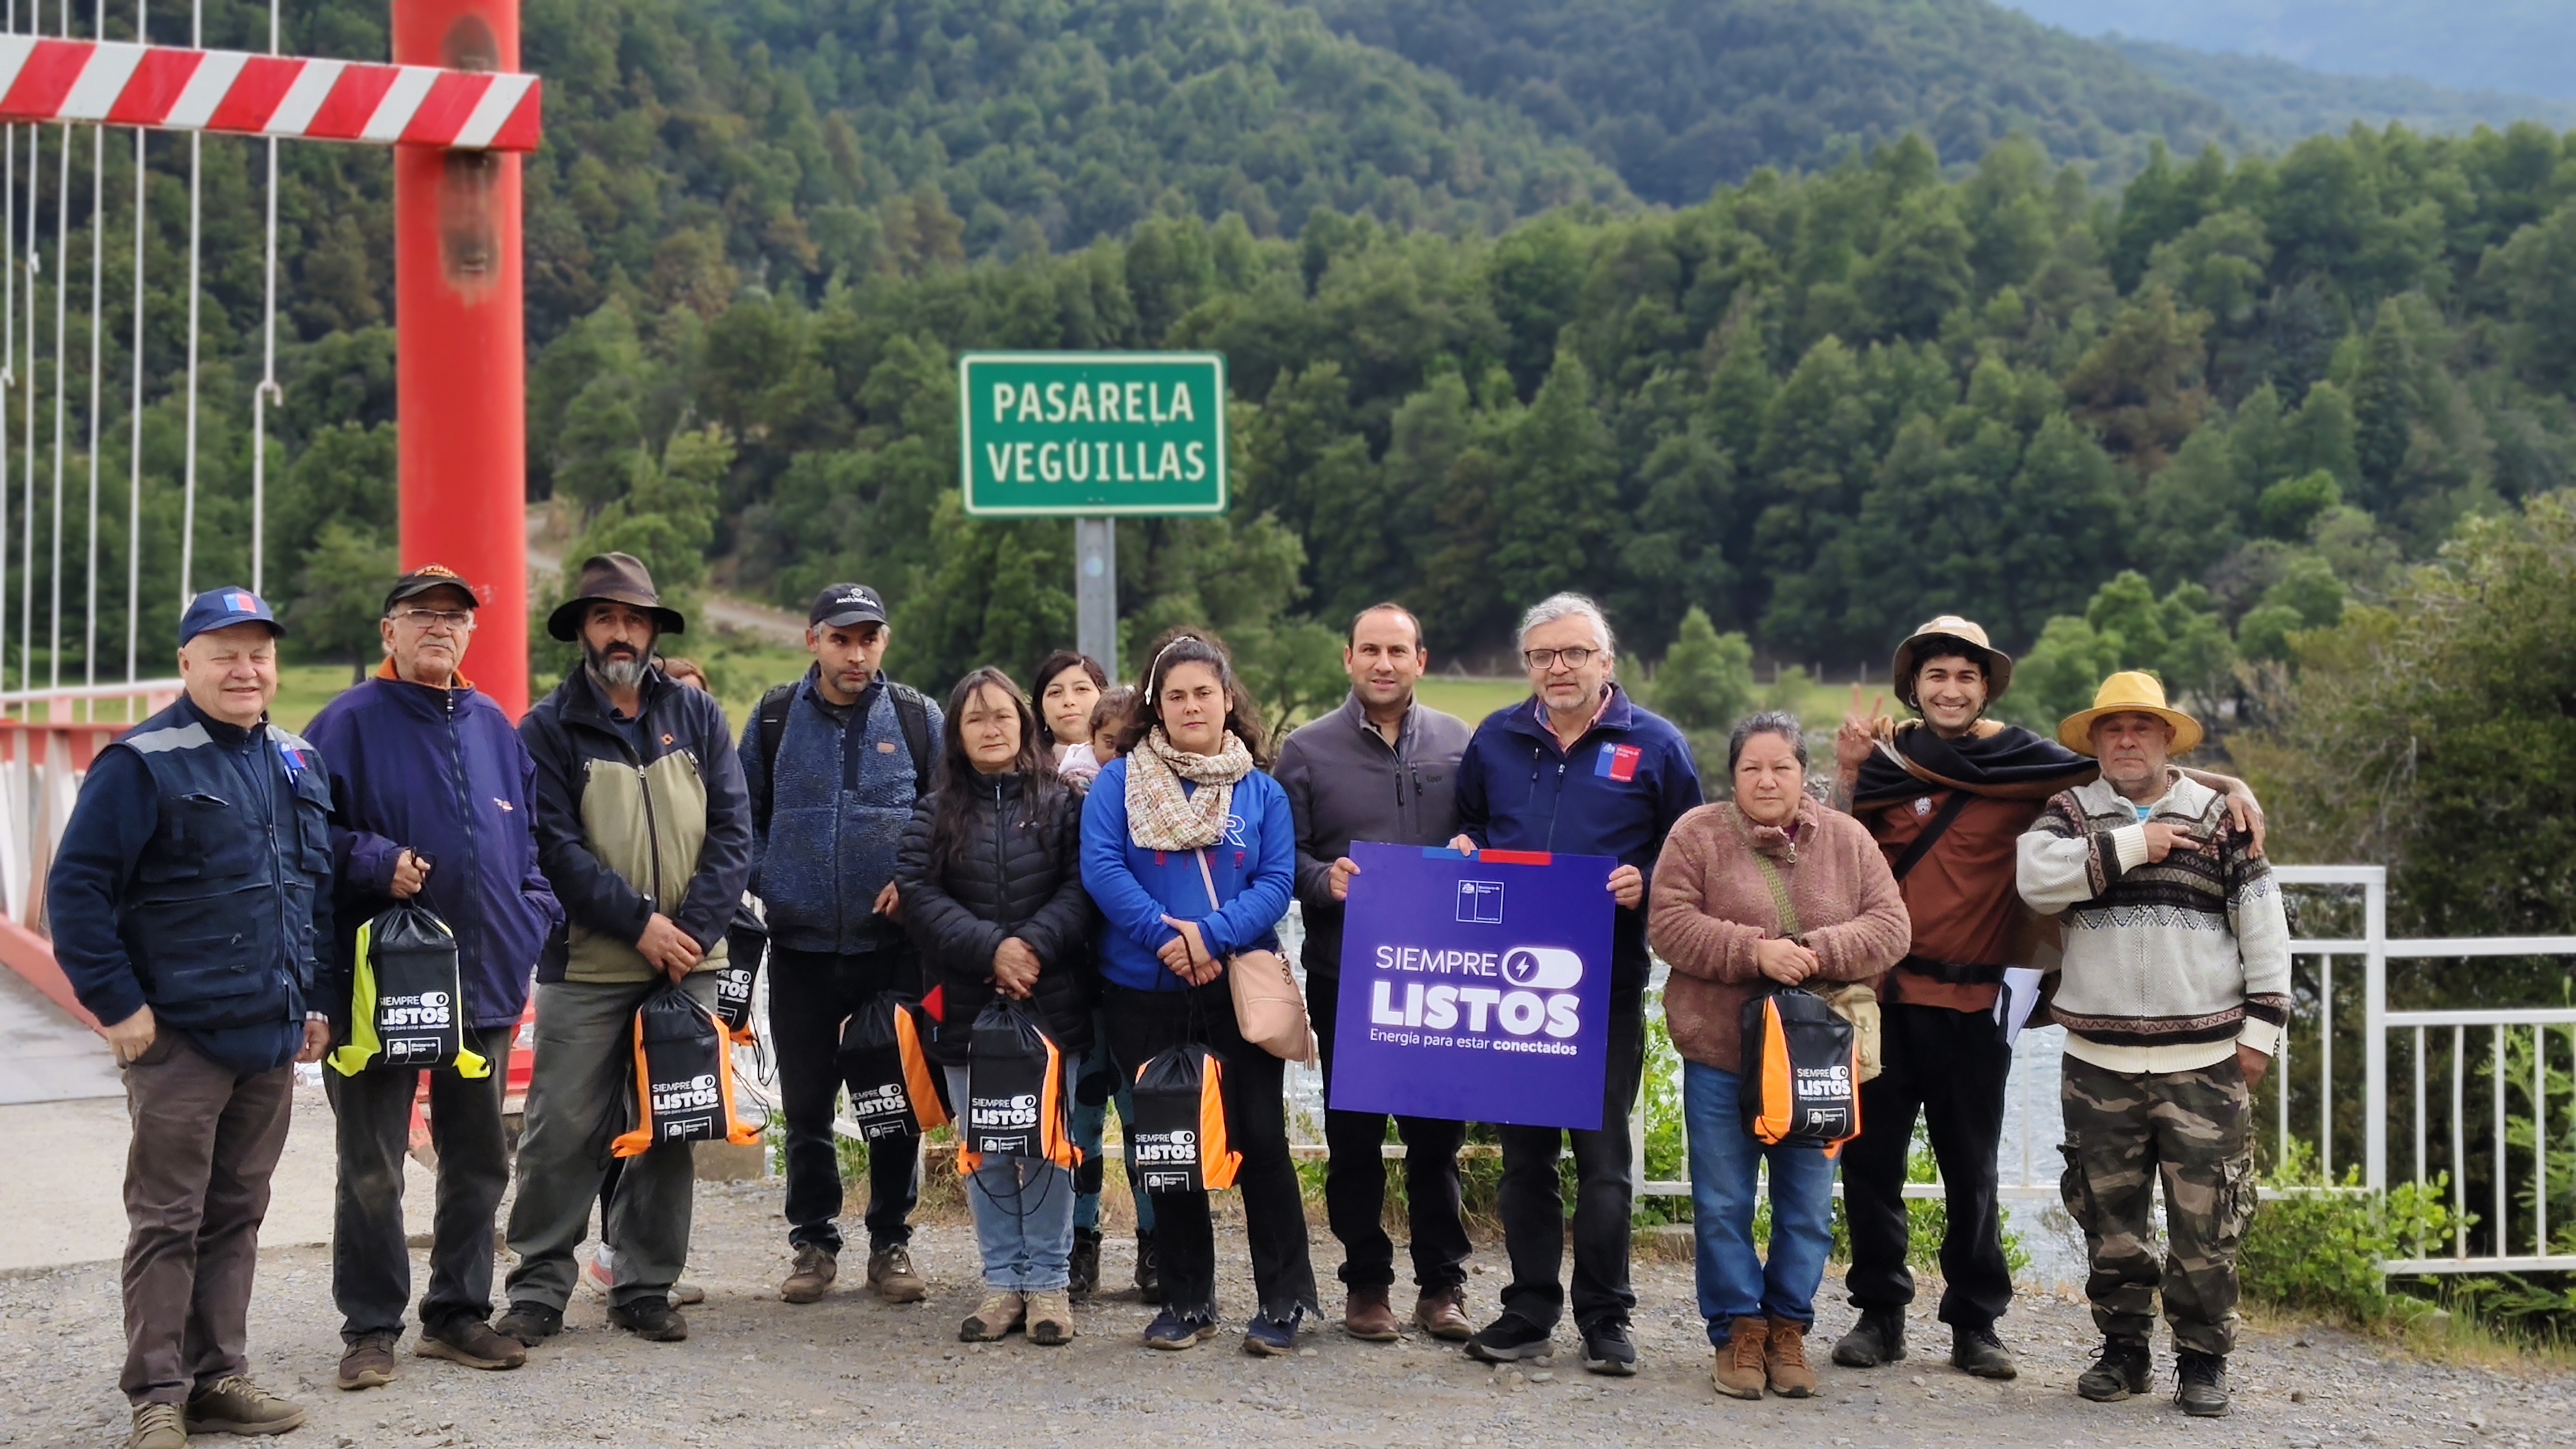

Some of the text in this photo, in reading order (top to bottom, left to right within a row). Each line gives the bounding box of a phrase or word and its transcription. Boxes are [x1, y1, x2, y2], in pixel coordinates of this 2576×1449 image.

[993, 382, 1194, 423] PASARELA
[1375, 945, 1499, 977] SIEMPRE
[381, 1006, 450, 1025] LISTOS
[1371, 980, 1580, 1038] LISTOS
[1370, 1028, 1577, 1056] Energía para estar conectados
[1797, 1068, 1830, 1077] SIEMPRE
[652, 1080, 692, 1092] SIEMPRE
[1798, 1079, 1851, 1096] LISTOS
[653, 1087, 718, 1110] LISTOS
[850, 1095, 906, 1116] LISTOS
[972, 1097, 1011, 1108] SIEMPRE
[972, 1108, 1037, 1125] LISTOS
[1135, 1134, 1170, 1143] SIEMPRE
[1136, 1145, 1196, 1160] LISTOS
